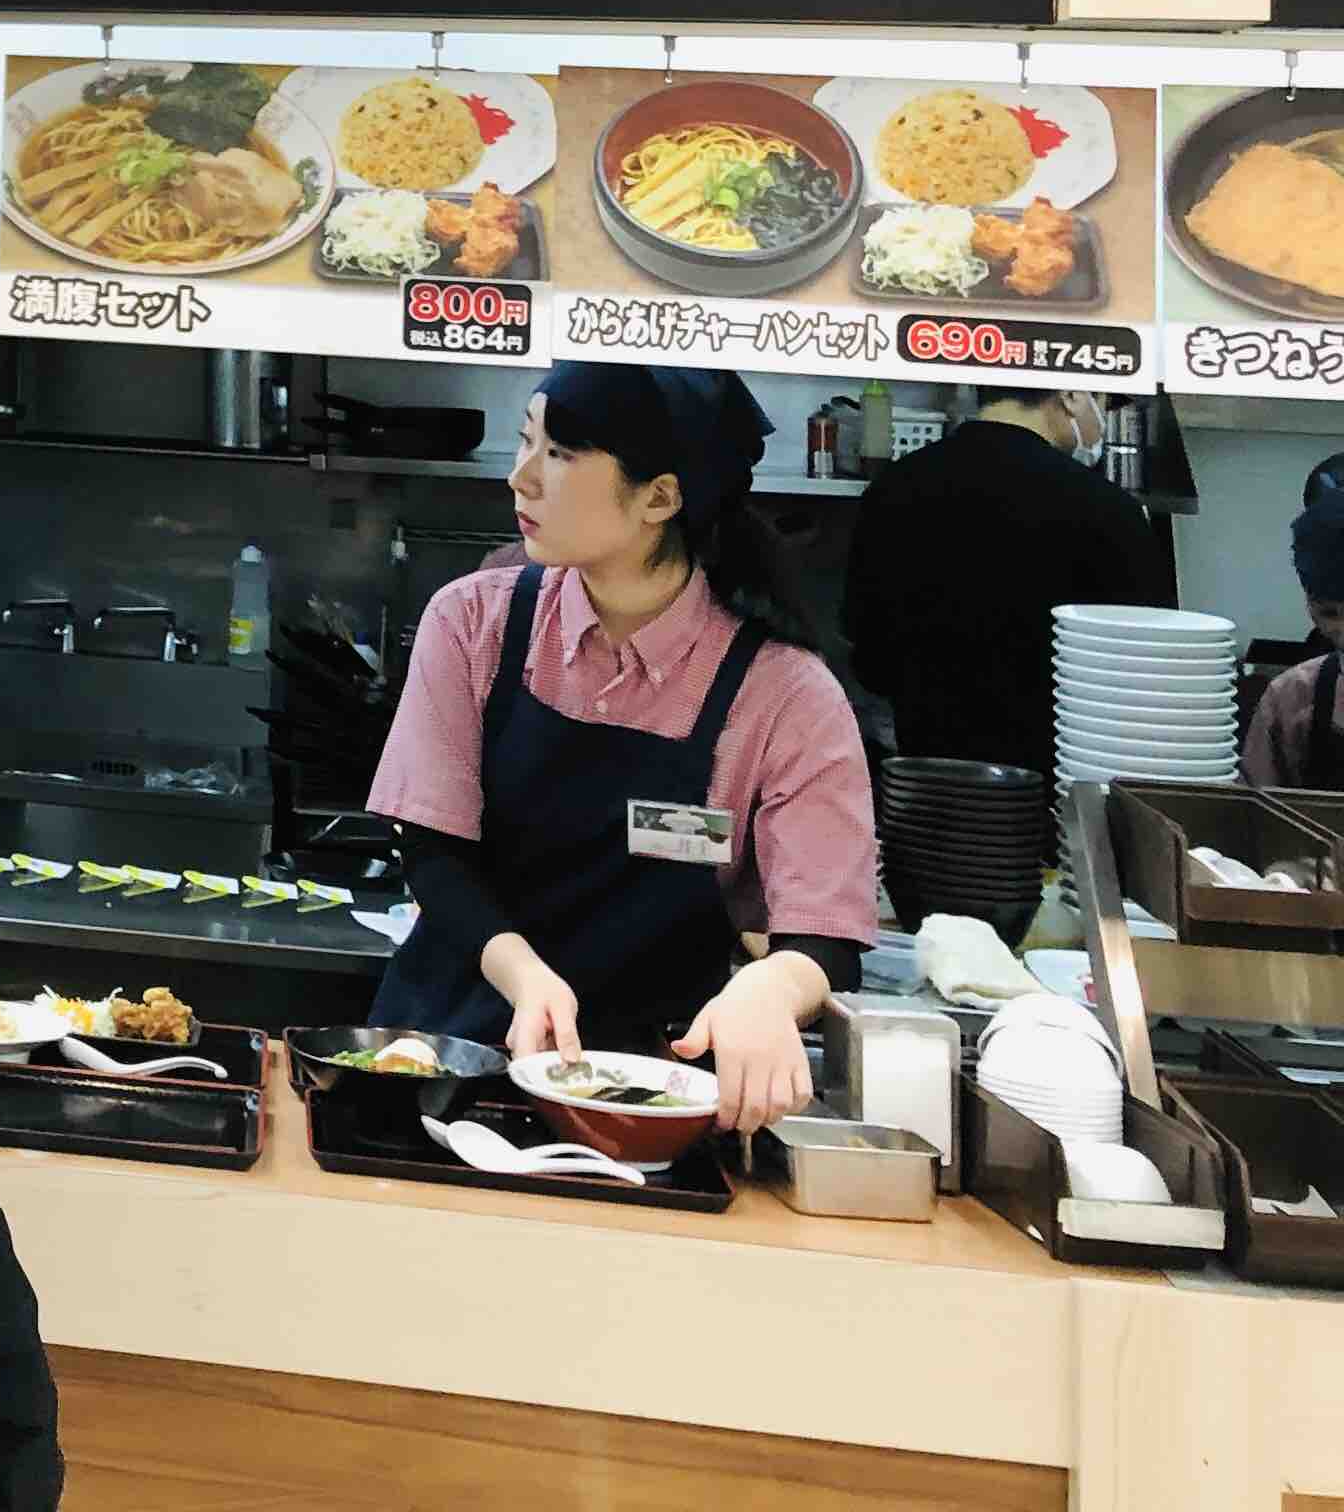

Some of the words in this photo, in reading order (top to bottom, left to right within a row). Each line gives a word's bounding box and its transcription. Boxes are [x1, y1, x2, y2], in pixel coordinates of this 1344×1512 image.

[11, 275, 211, 333] 満腹セット
[408, 282, 526, 326] 800円
[567, 298, 889, 361] からあげチャーハンセット
[906, 319, 1027, 365] 690円
